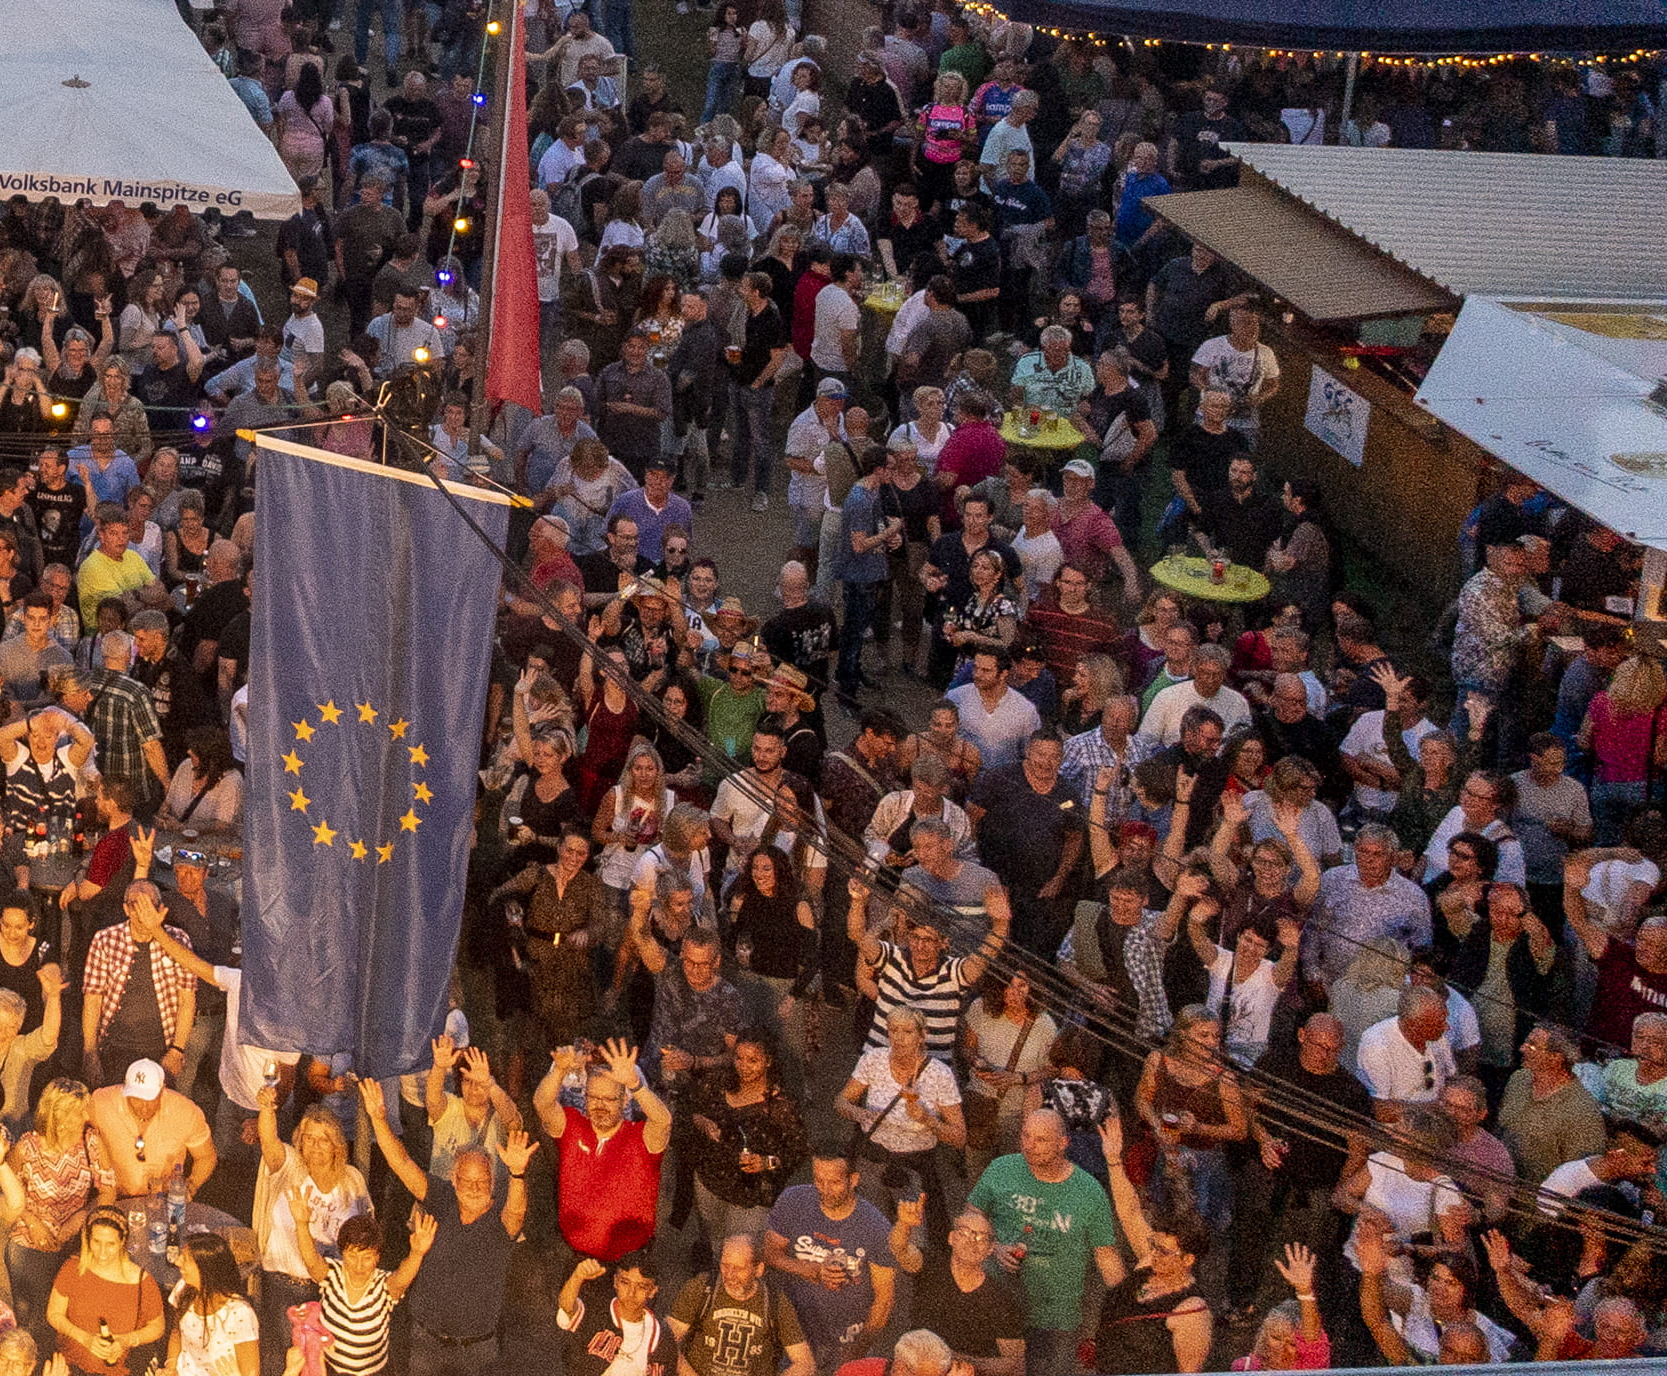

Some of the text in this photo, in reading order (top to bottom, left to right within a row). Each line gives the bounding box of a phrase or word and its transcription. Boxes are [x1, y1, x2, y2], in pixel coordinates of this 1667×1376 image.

[103, 180, 209, 203] Mainspitze
[215, 190, 242, 207] eG
[37, 491, 73, 503] UNHEILIG
[713, 1319, 755, 1369] H
